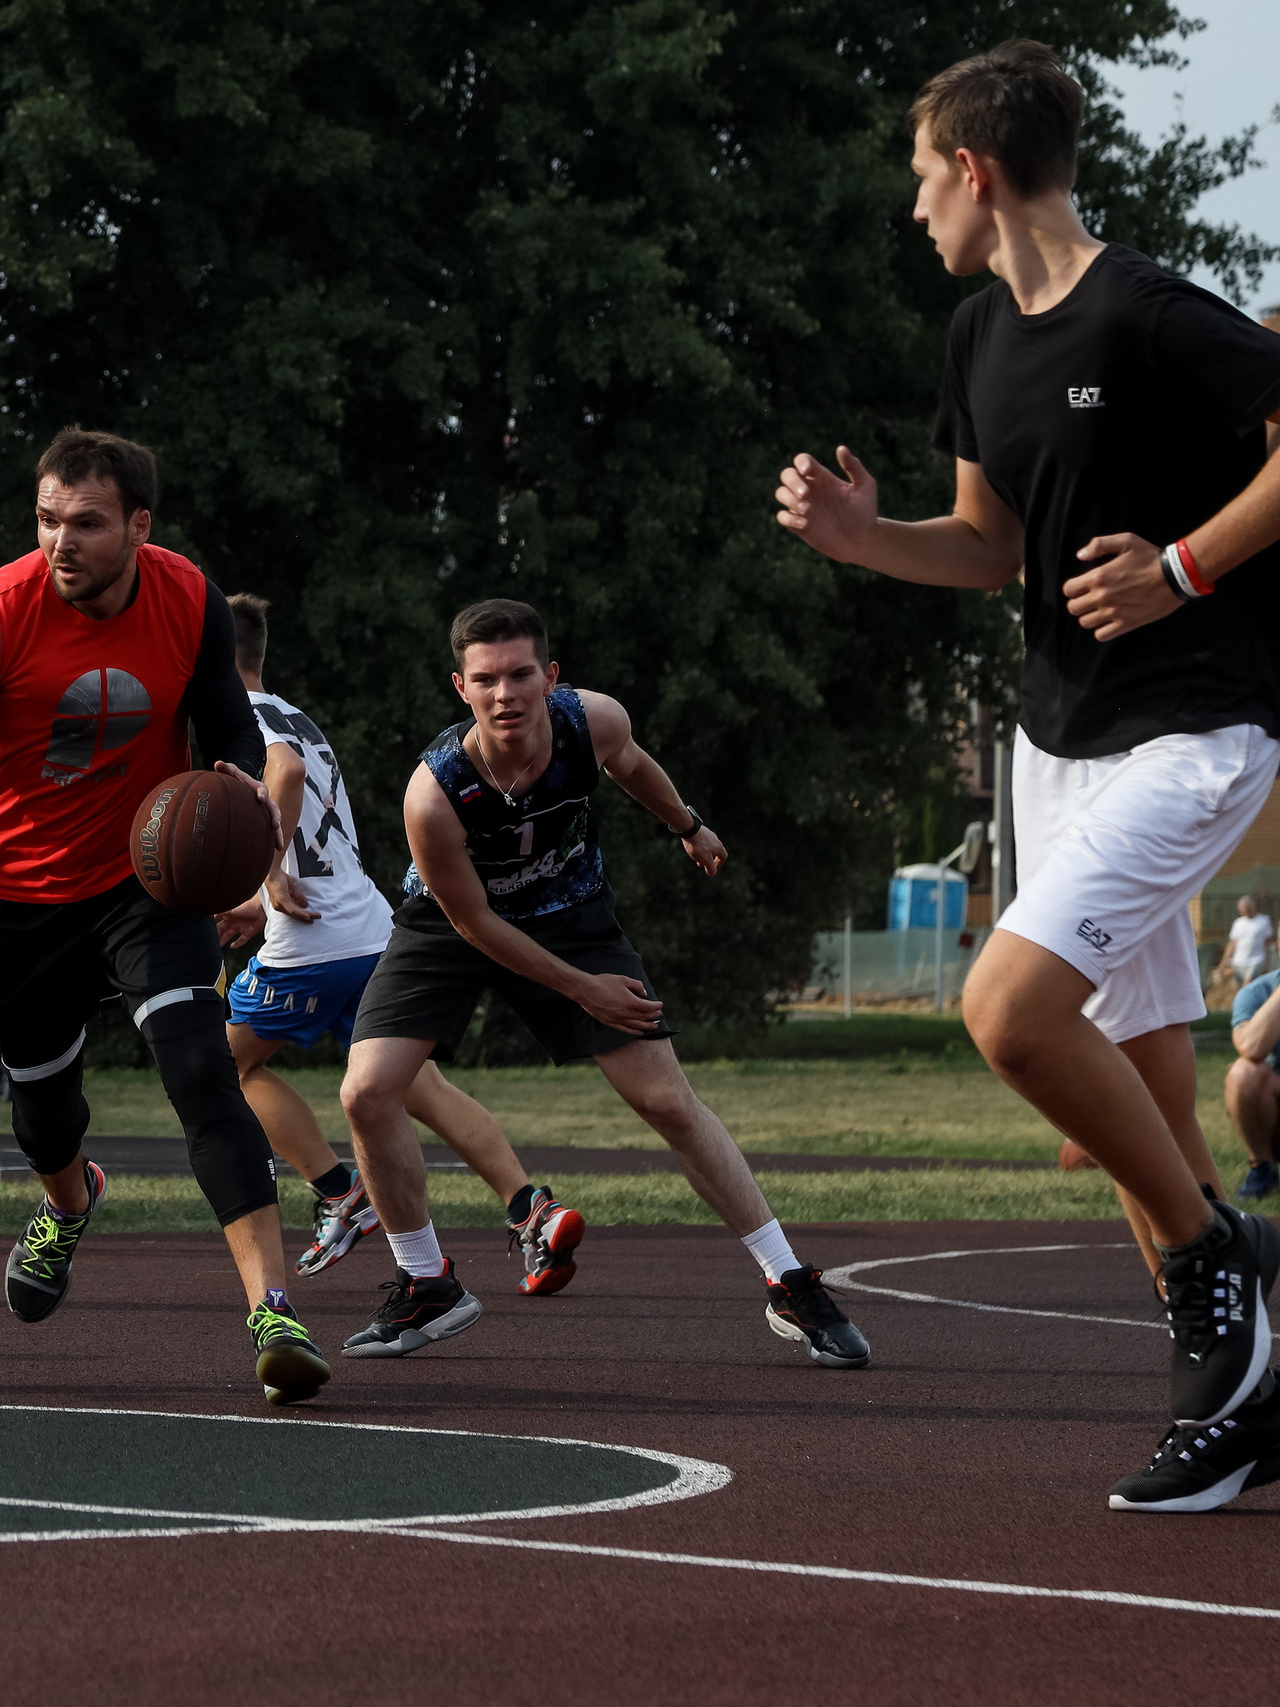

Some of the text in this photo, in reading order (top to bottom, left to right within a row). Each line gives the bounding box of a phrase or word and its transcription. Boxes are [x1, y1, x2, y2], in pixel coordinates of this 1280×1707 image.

[1067, 387, 1101, 403] EA7
[140, 787, 178, 885] Wilson
[513, 821, 534, 856] 1
[1078, 918, 1113, 947] EA7
